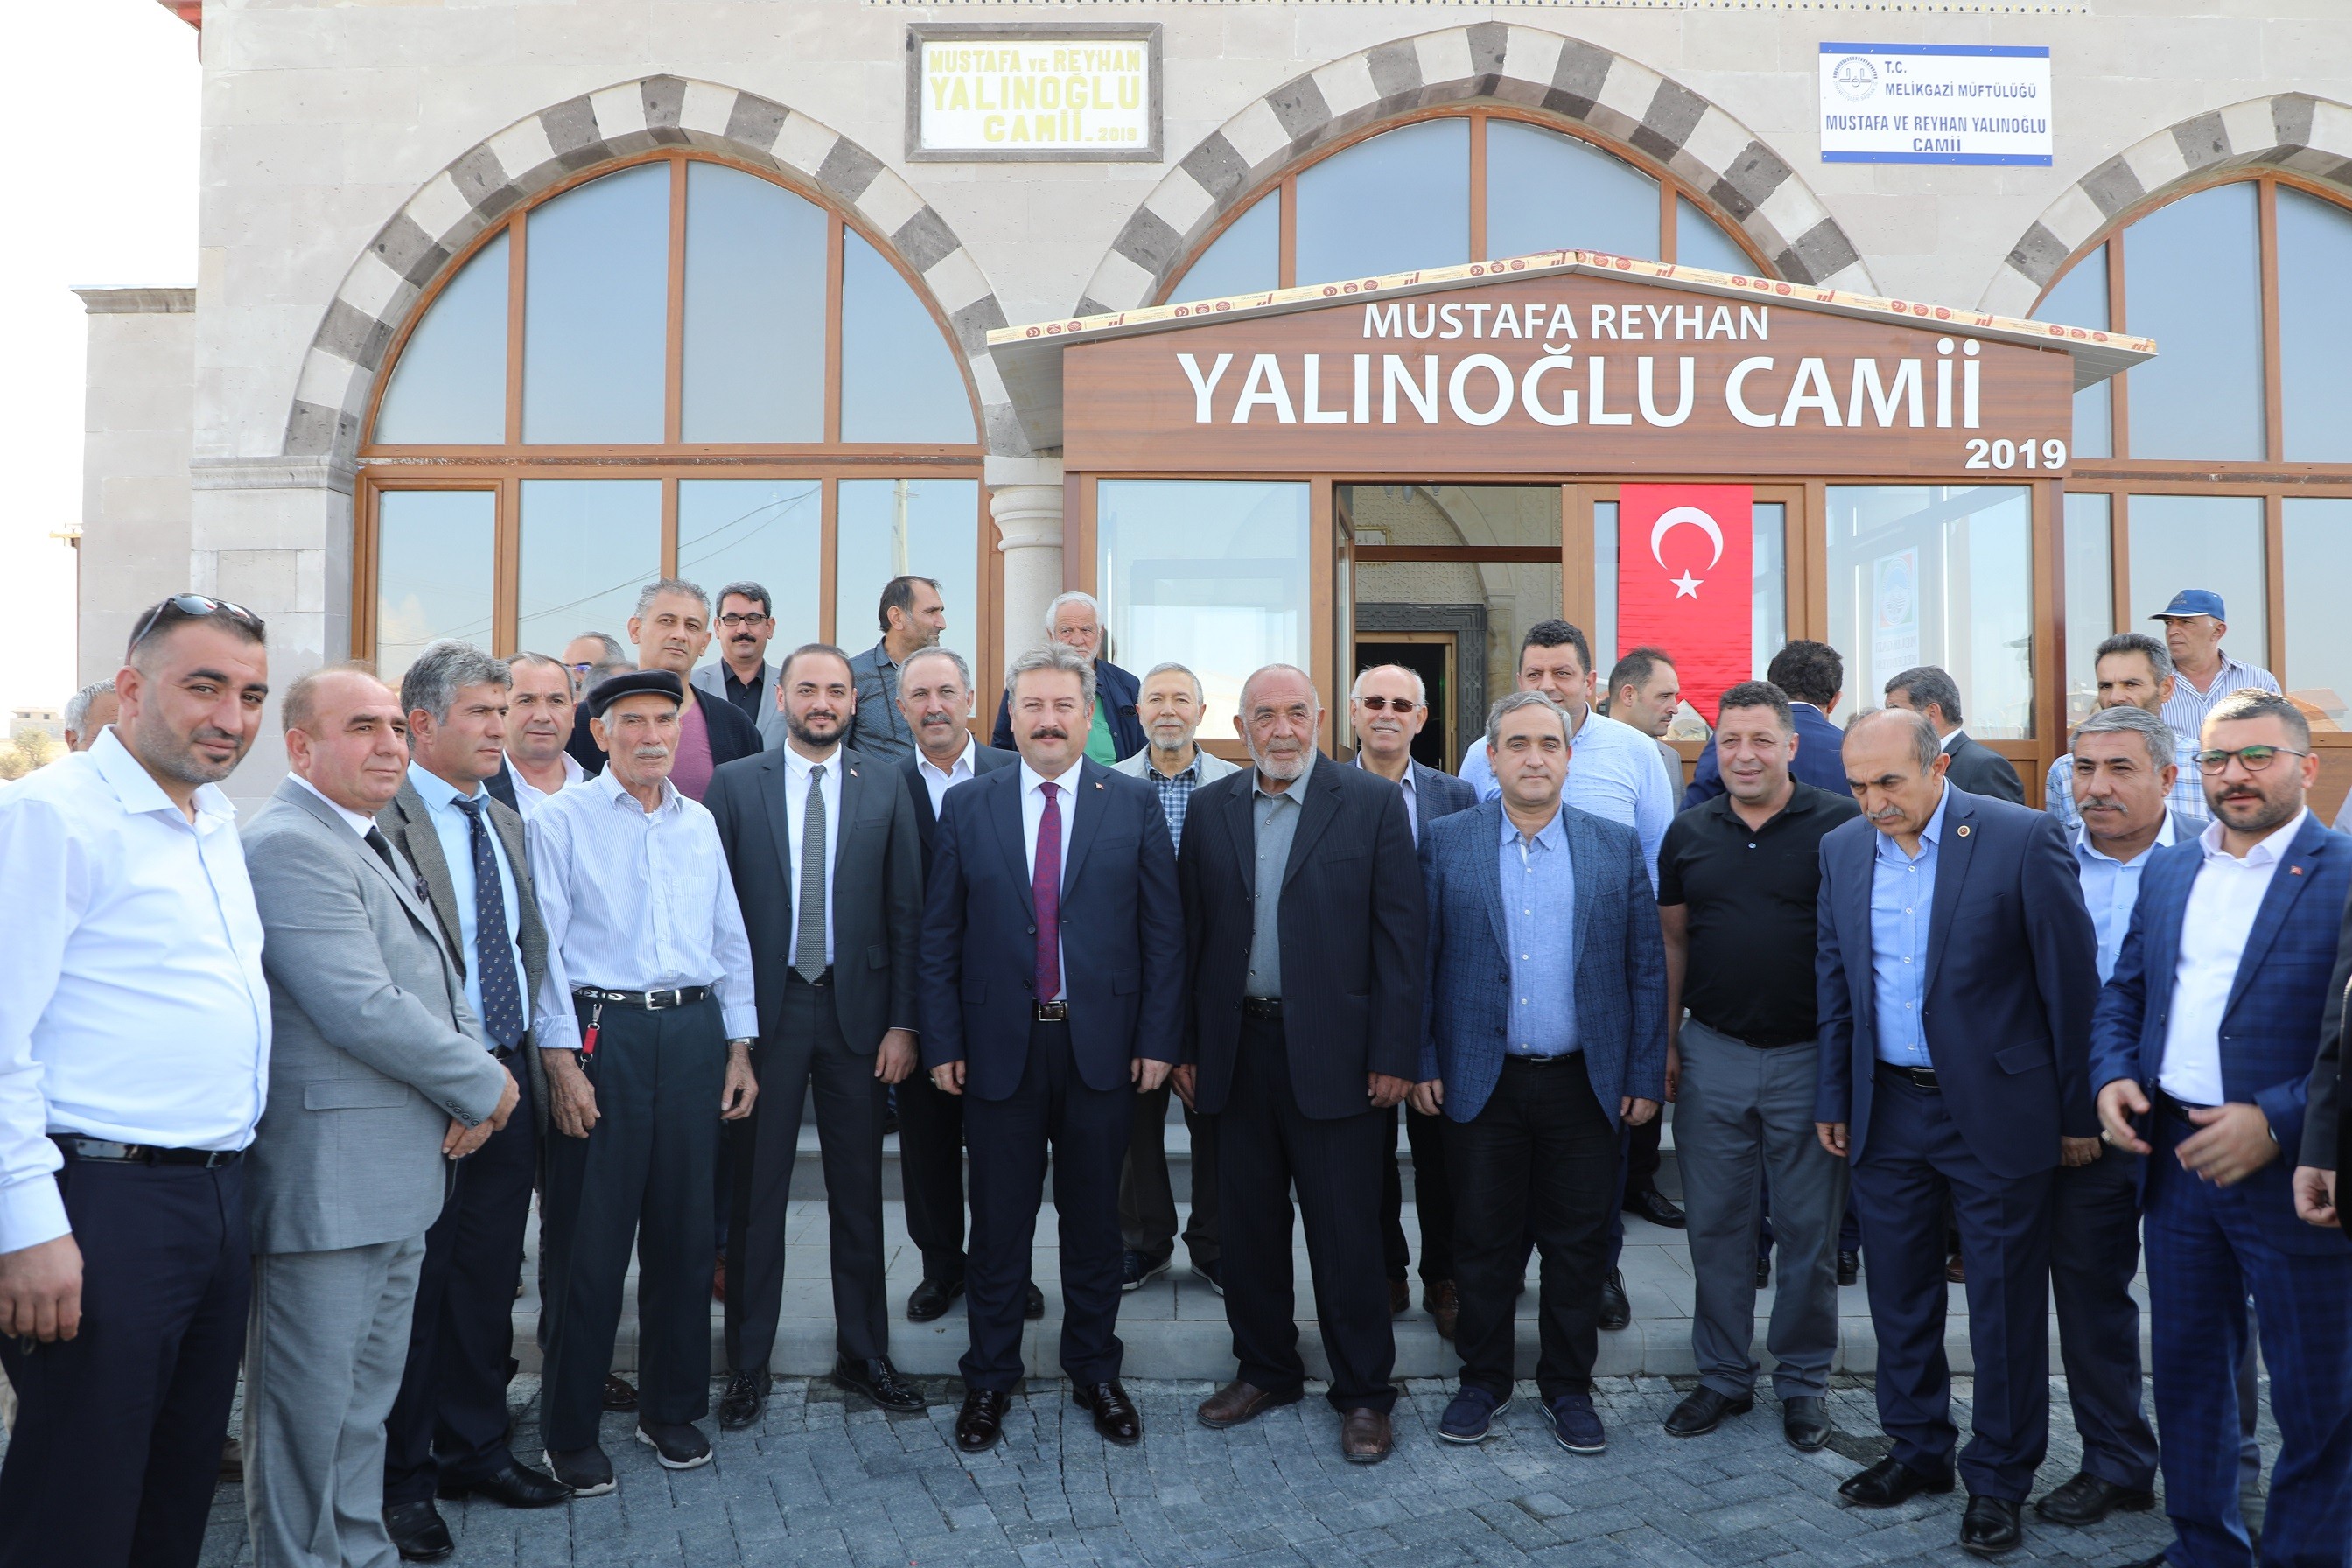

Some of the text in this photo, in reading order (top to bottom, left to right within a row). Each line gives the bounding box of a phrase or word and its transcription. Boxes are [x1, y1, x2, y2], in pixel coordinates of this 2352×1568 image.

[929, 49, 1141, 73] MUSTAFA VE REYHAN
[1885, 60, 1908, 74] T.C.
[929, 72, 1141, 110] YALINOĞLU
[1885, 80, 2037, 98] MELİKGAZİ MÜFTÜLÜĞÜ
[984, 109, 1082, 142] CAMİİ
[1098, 127, 1138, 142] 2019
[1825, 115, 2047, 134] MUSTAFA VE REYHAN YALINOĞLU
[1913, 135, 1962, 152] CAMİİ
[1362, 303, 1769, 341] MUSTAFA REYHAN
[1176, 338, 1980, 429] YALINOĞLU CAMİİ
[1964, 438, 2067, 470] 2019
